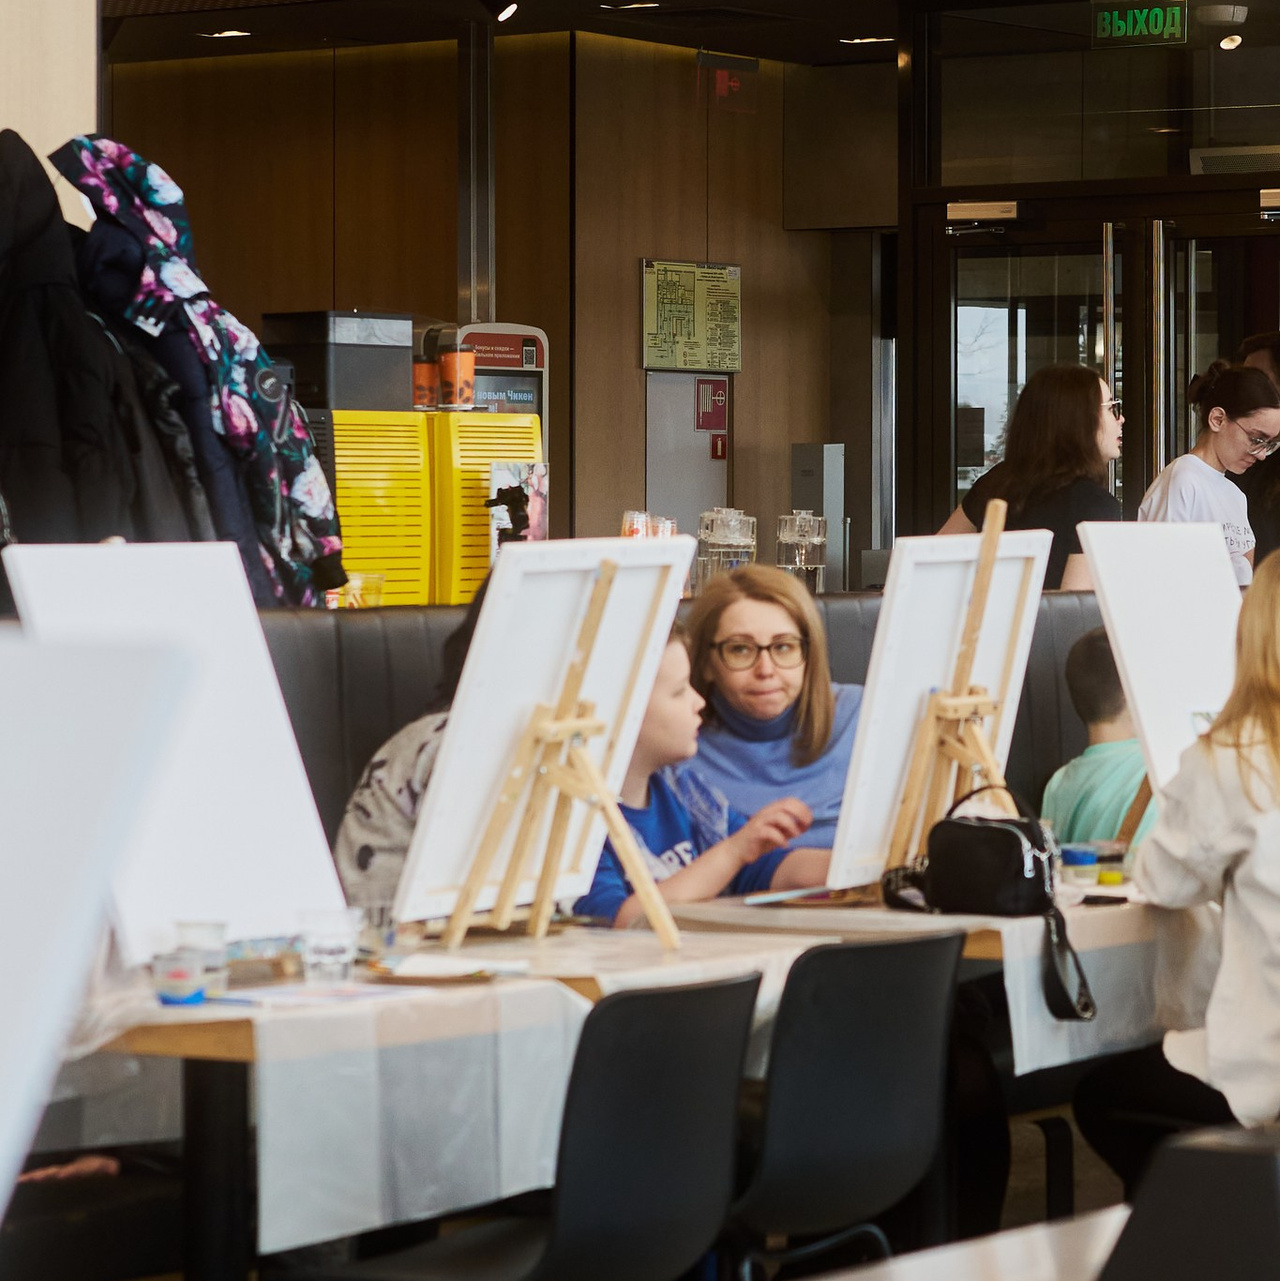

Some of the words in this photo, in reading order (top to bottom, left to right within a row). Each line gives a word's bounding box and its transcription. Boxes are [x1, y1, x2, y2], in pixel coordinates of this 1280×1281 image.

[1096, 6, 1182, 39] ВЫХОД
[477, 391, 505, 400] новым
[507, 390, 533, 401] Чикен
